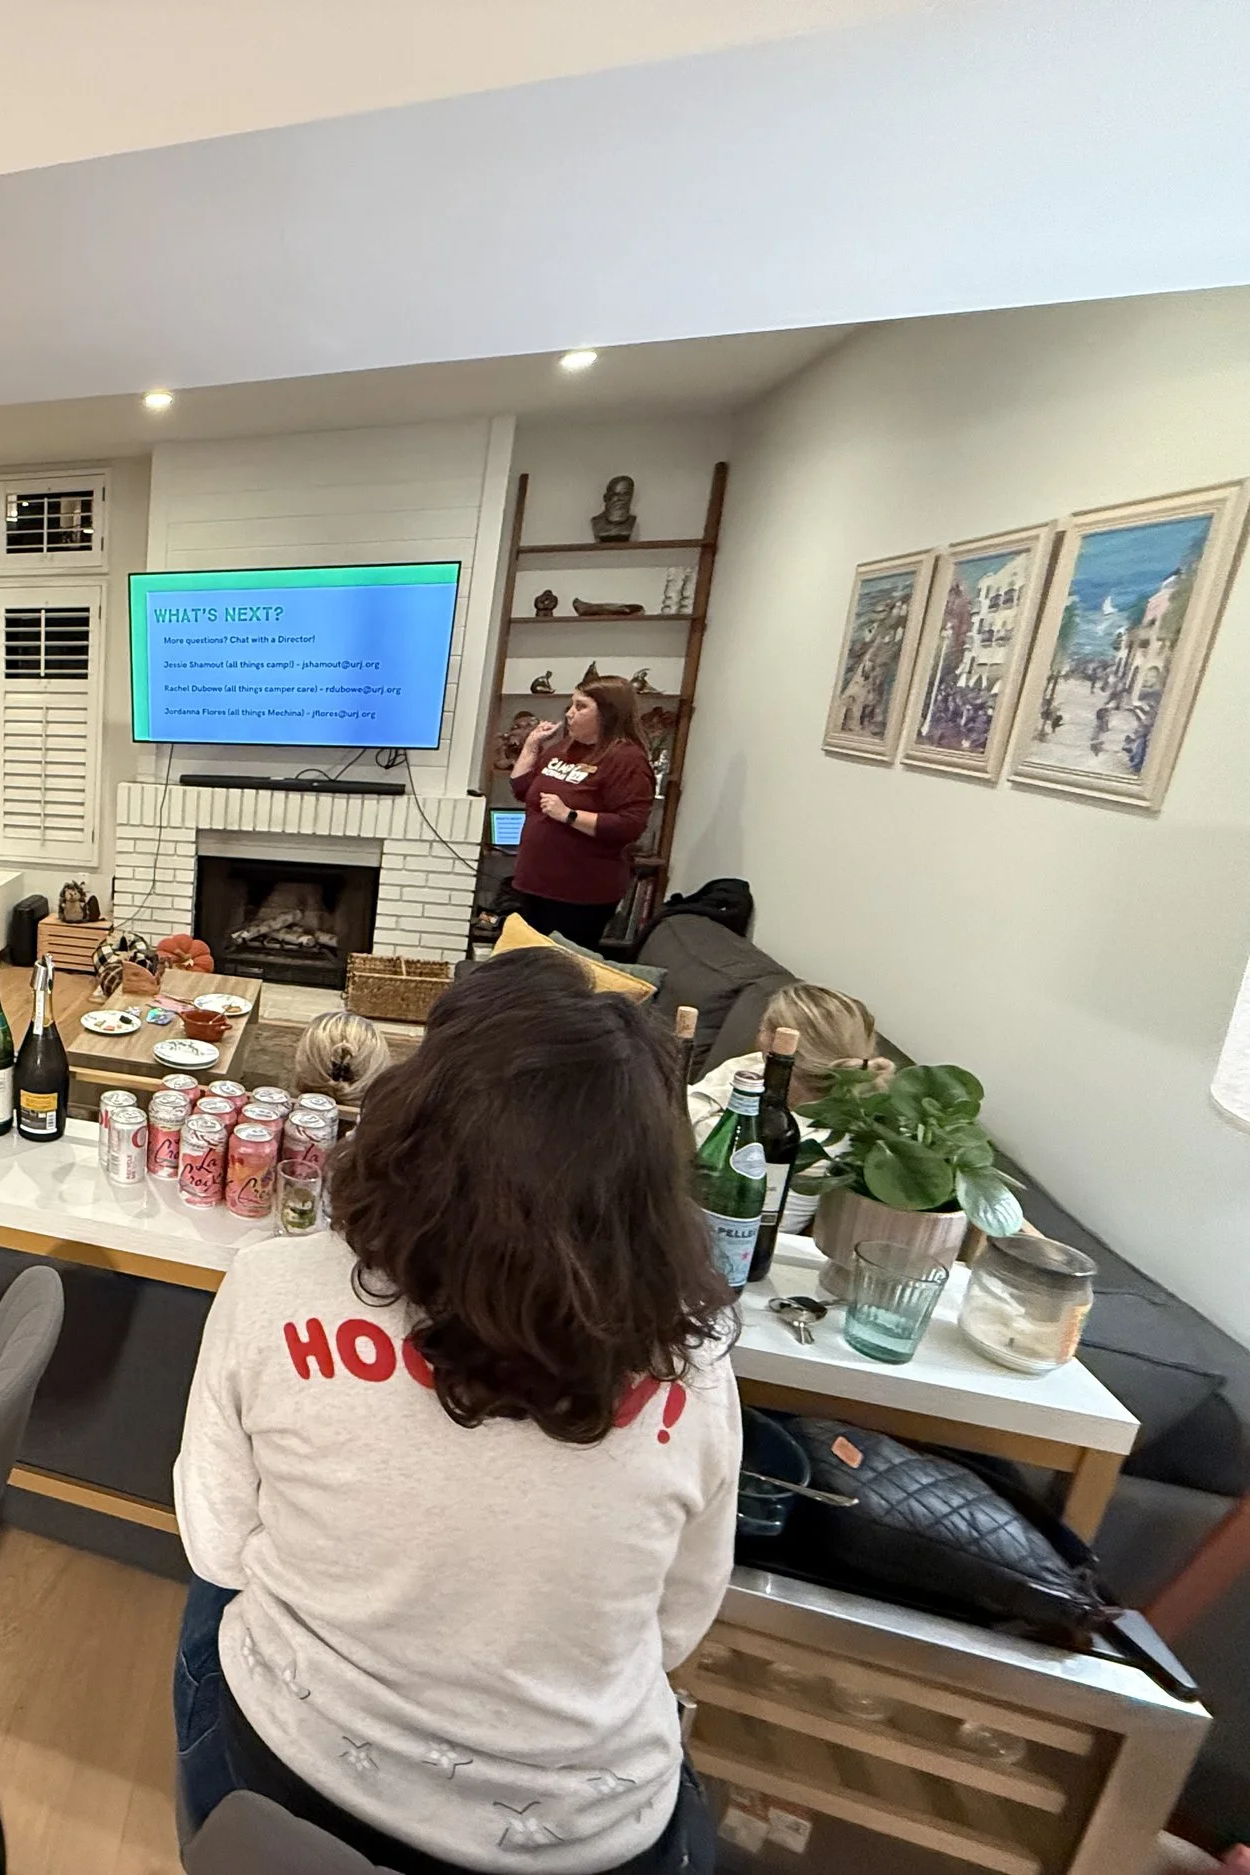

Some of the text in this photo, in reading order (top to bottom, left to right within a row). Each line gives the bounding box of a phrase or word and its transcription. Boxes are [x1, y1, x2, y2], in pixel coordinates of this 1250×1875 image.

[154, 606, 284, 624] WHAT'S NEXT?
[163, 636, 184, 645] More
[185, 636, 228, 647] questions?
[229, 635, 250, 644] Chat
[251, 636, 270, 644] with
[278, 635, 315, 644] Director!
[163, 660, 188, 669] Jessie
[189, 660, 224, 669] Shamout
[225, 660, 238, 669] (all
[240, 660, 265, 670] things
[266, 660, 295, 670] camp!)
[164, 684, 190, 693] Rachel
[224, 684, 236, 693] (all
[238, 685, 263, 695] things
[264, 685, 295, 695] camper
[296, 684, 318, 694] care)
[164, 707, 200, 716] Jordanna
[202, 707, 226, 716] Flores
[227, 707, 240, 717] (all
[241, 708, 266, 718] things
[267, 708, 305, 718] Mechina)
